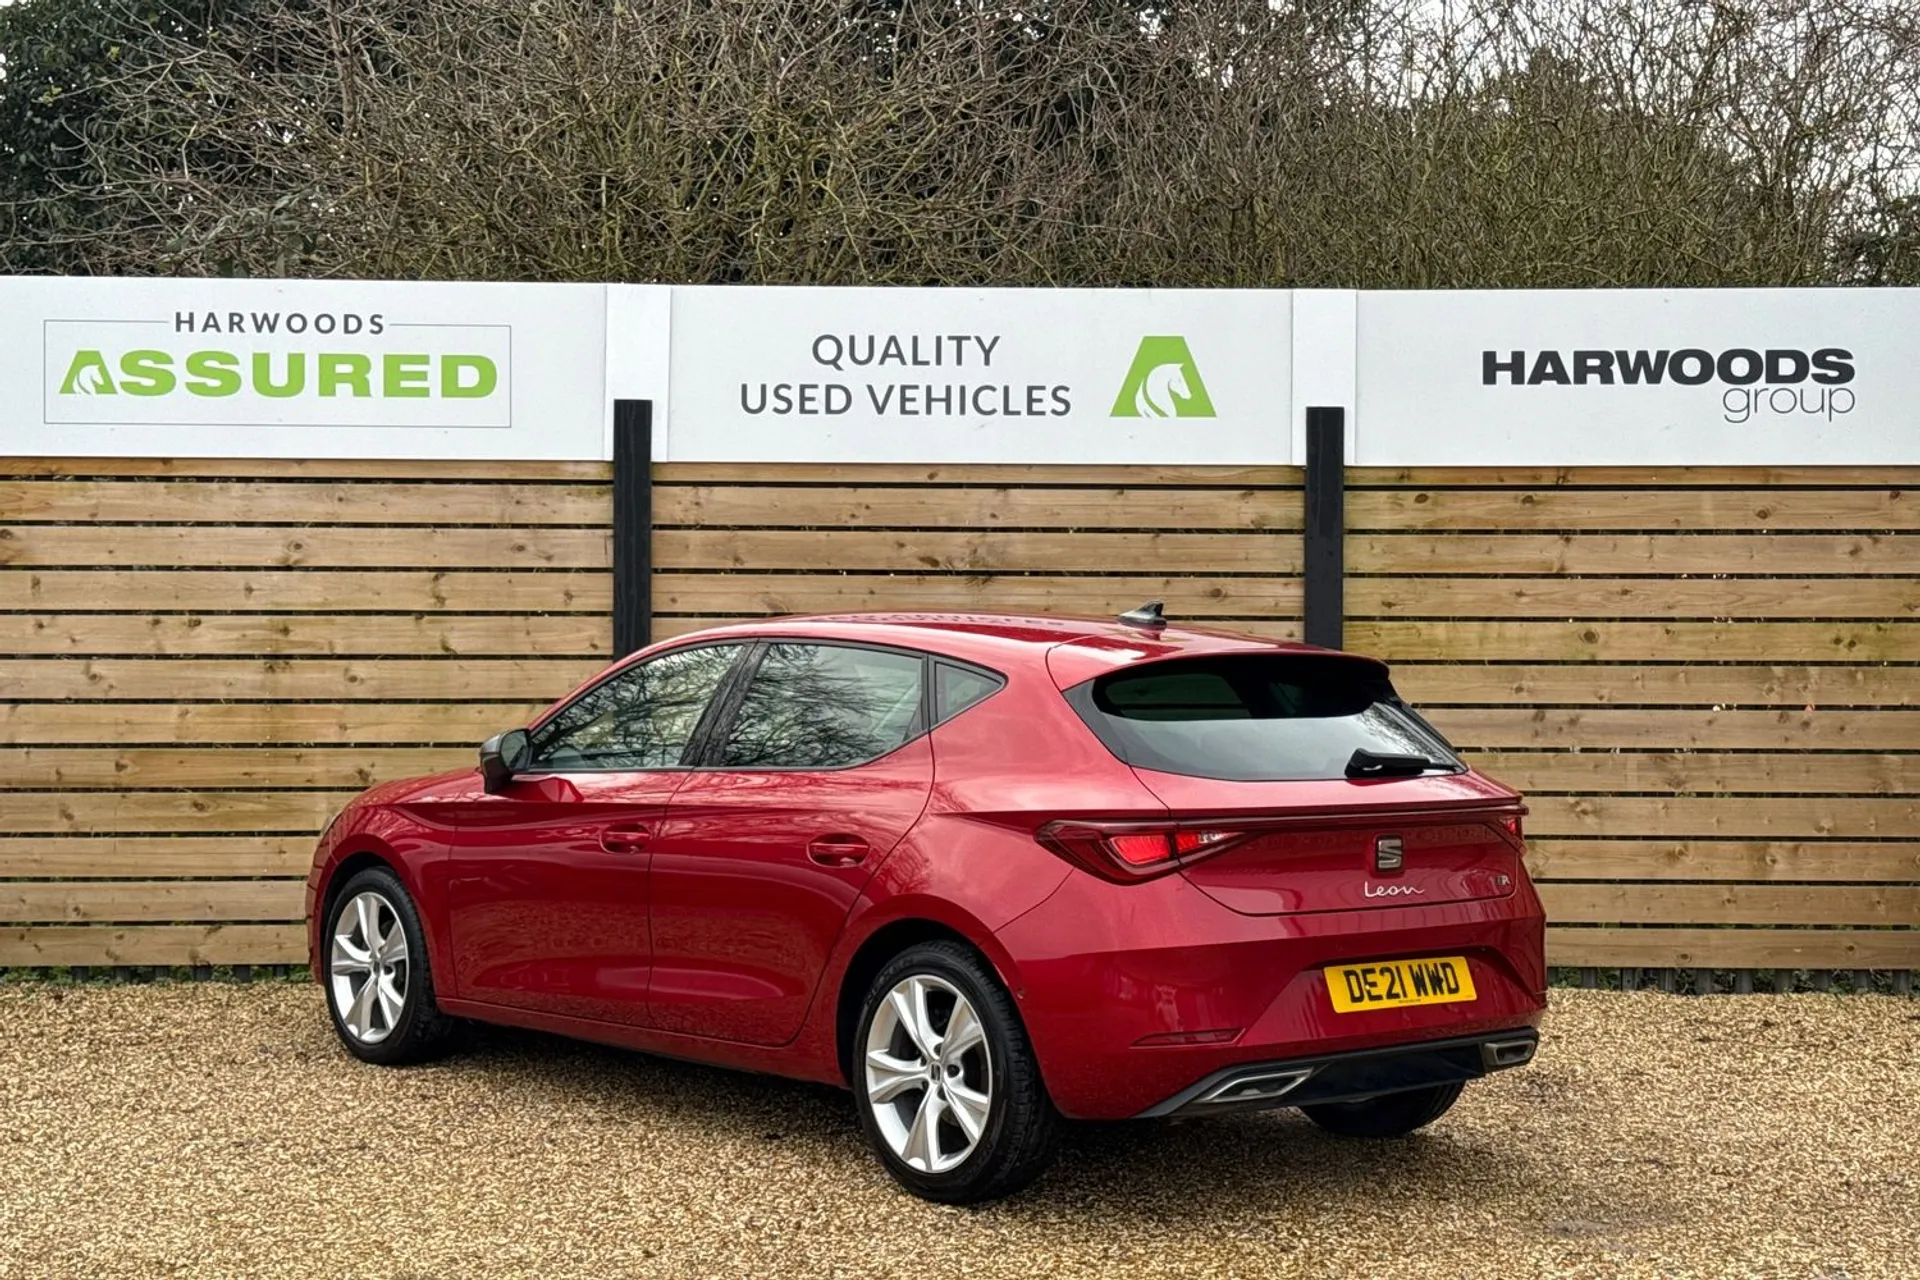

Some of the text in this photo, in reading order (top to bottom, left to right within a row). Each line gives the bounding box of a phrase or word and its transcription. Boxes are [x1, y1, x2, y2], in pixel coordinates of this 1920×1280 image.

[175, 311, 385, 336] HARWOODS
[812, 334, 1001, 369] QUALITY
[1482, 348, 1857, 386] HARWOODS
[59, 349, 498, 400] ASSURED
[740, 383, 1072, 418] USED VEHICLES
[1722, 385, 1857, 424] group
[1364, 881, 1425, 898] Leon
[1343, 961, 1461, 1003] DE21 WWD
